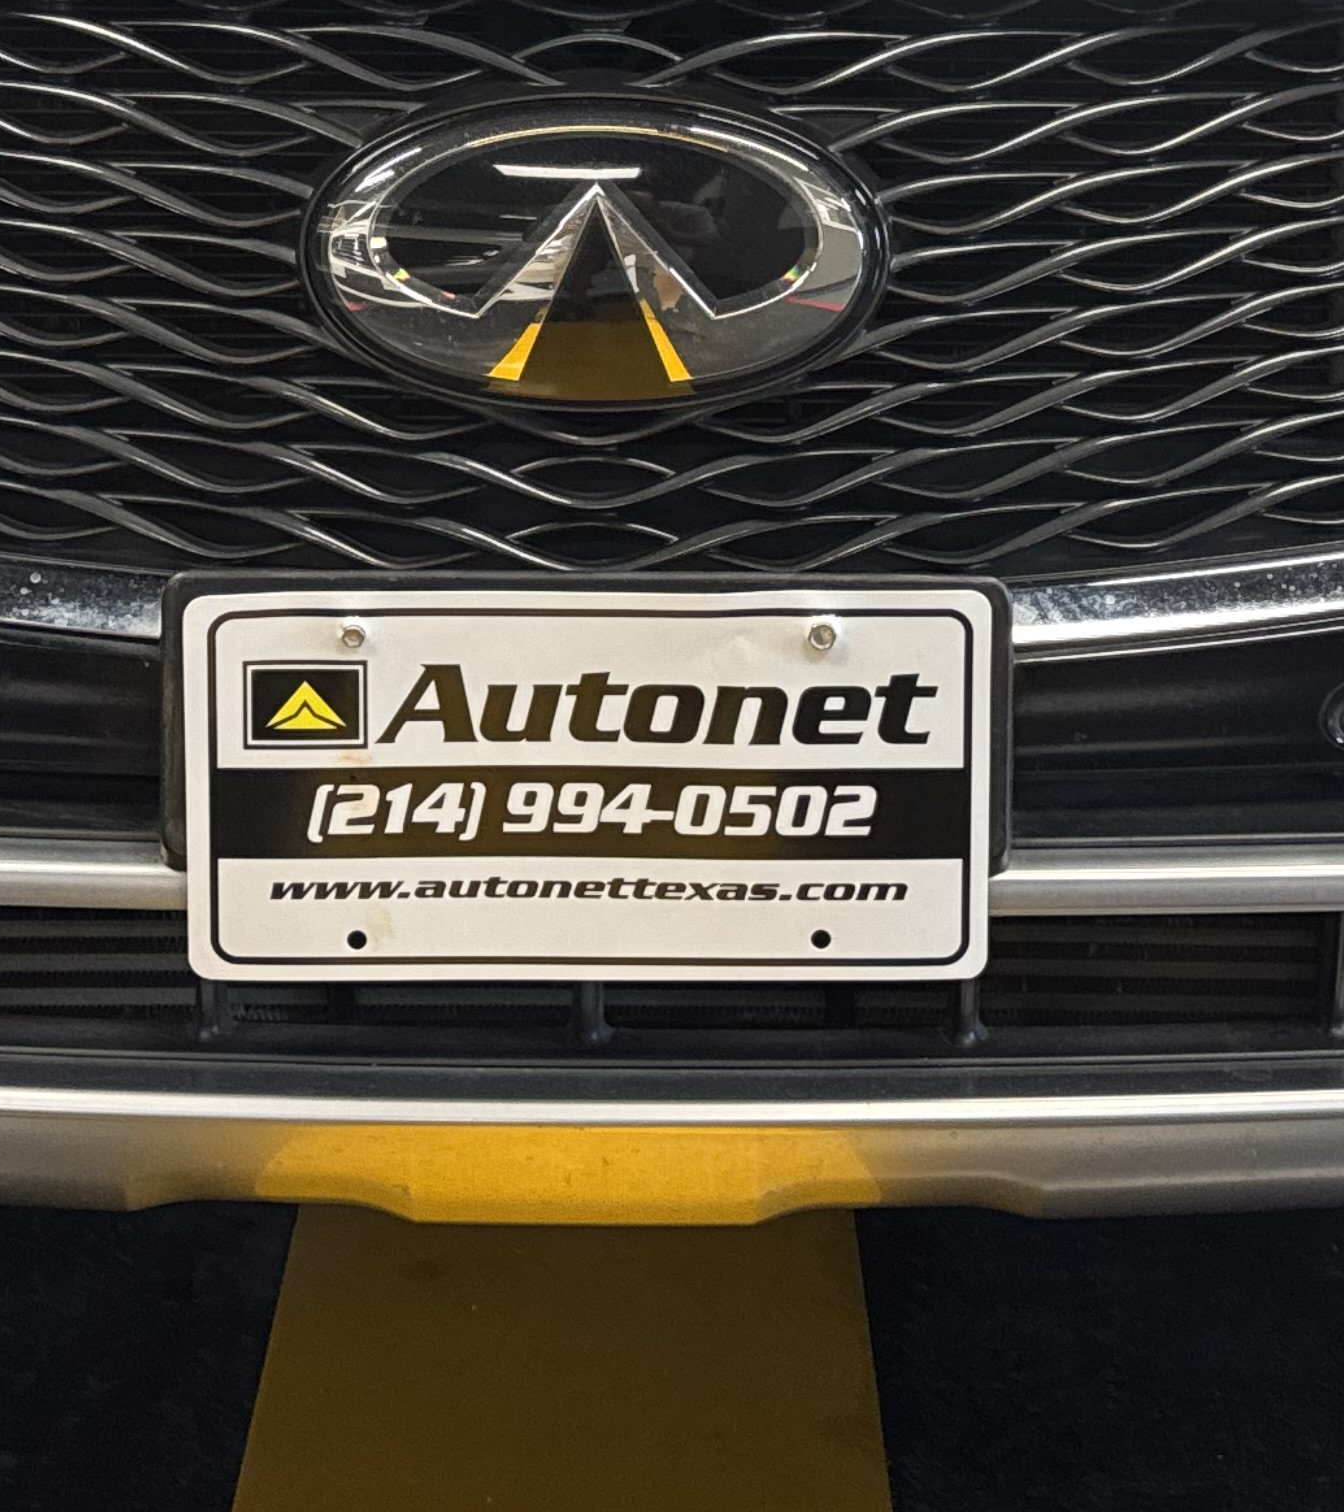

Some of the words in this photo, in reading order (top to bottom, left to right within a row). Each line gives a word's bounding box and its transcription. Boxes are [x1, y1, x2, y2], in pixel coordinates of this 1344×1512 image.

[375, 663, 938, 745] Autonet
[306, 781, 487, 843] (214)
[502, 782, 877, 836] 994-0502
[270, 876, 908, 901] www.autonettexas.com
